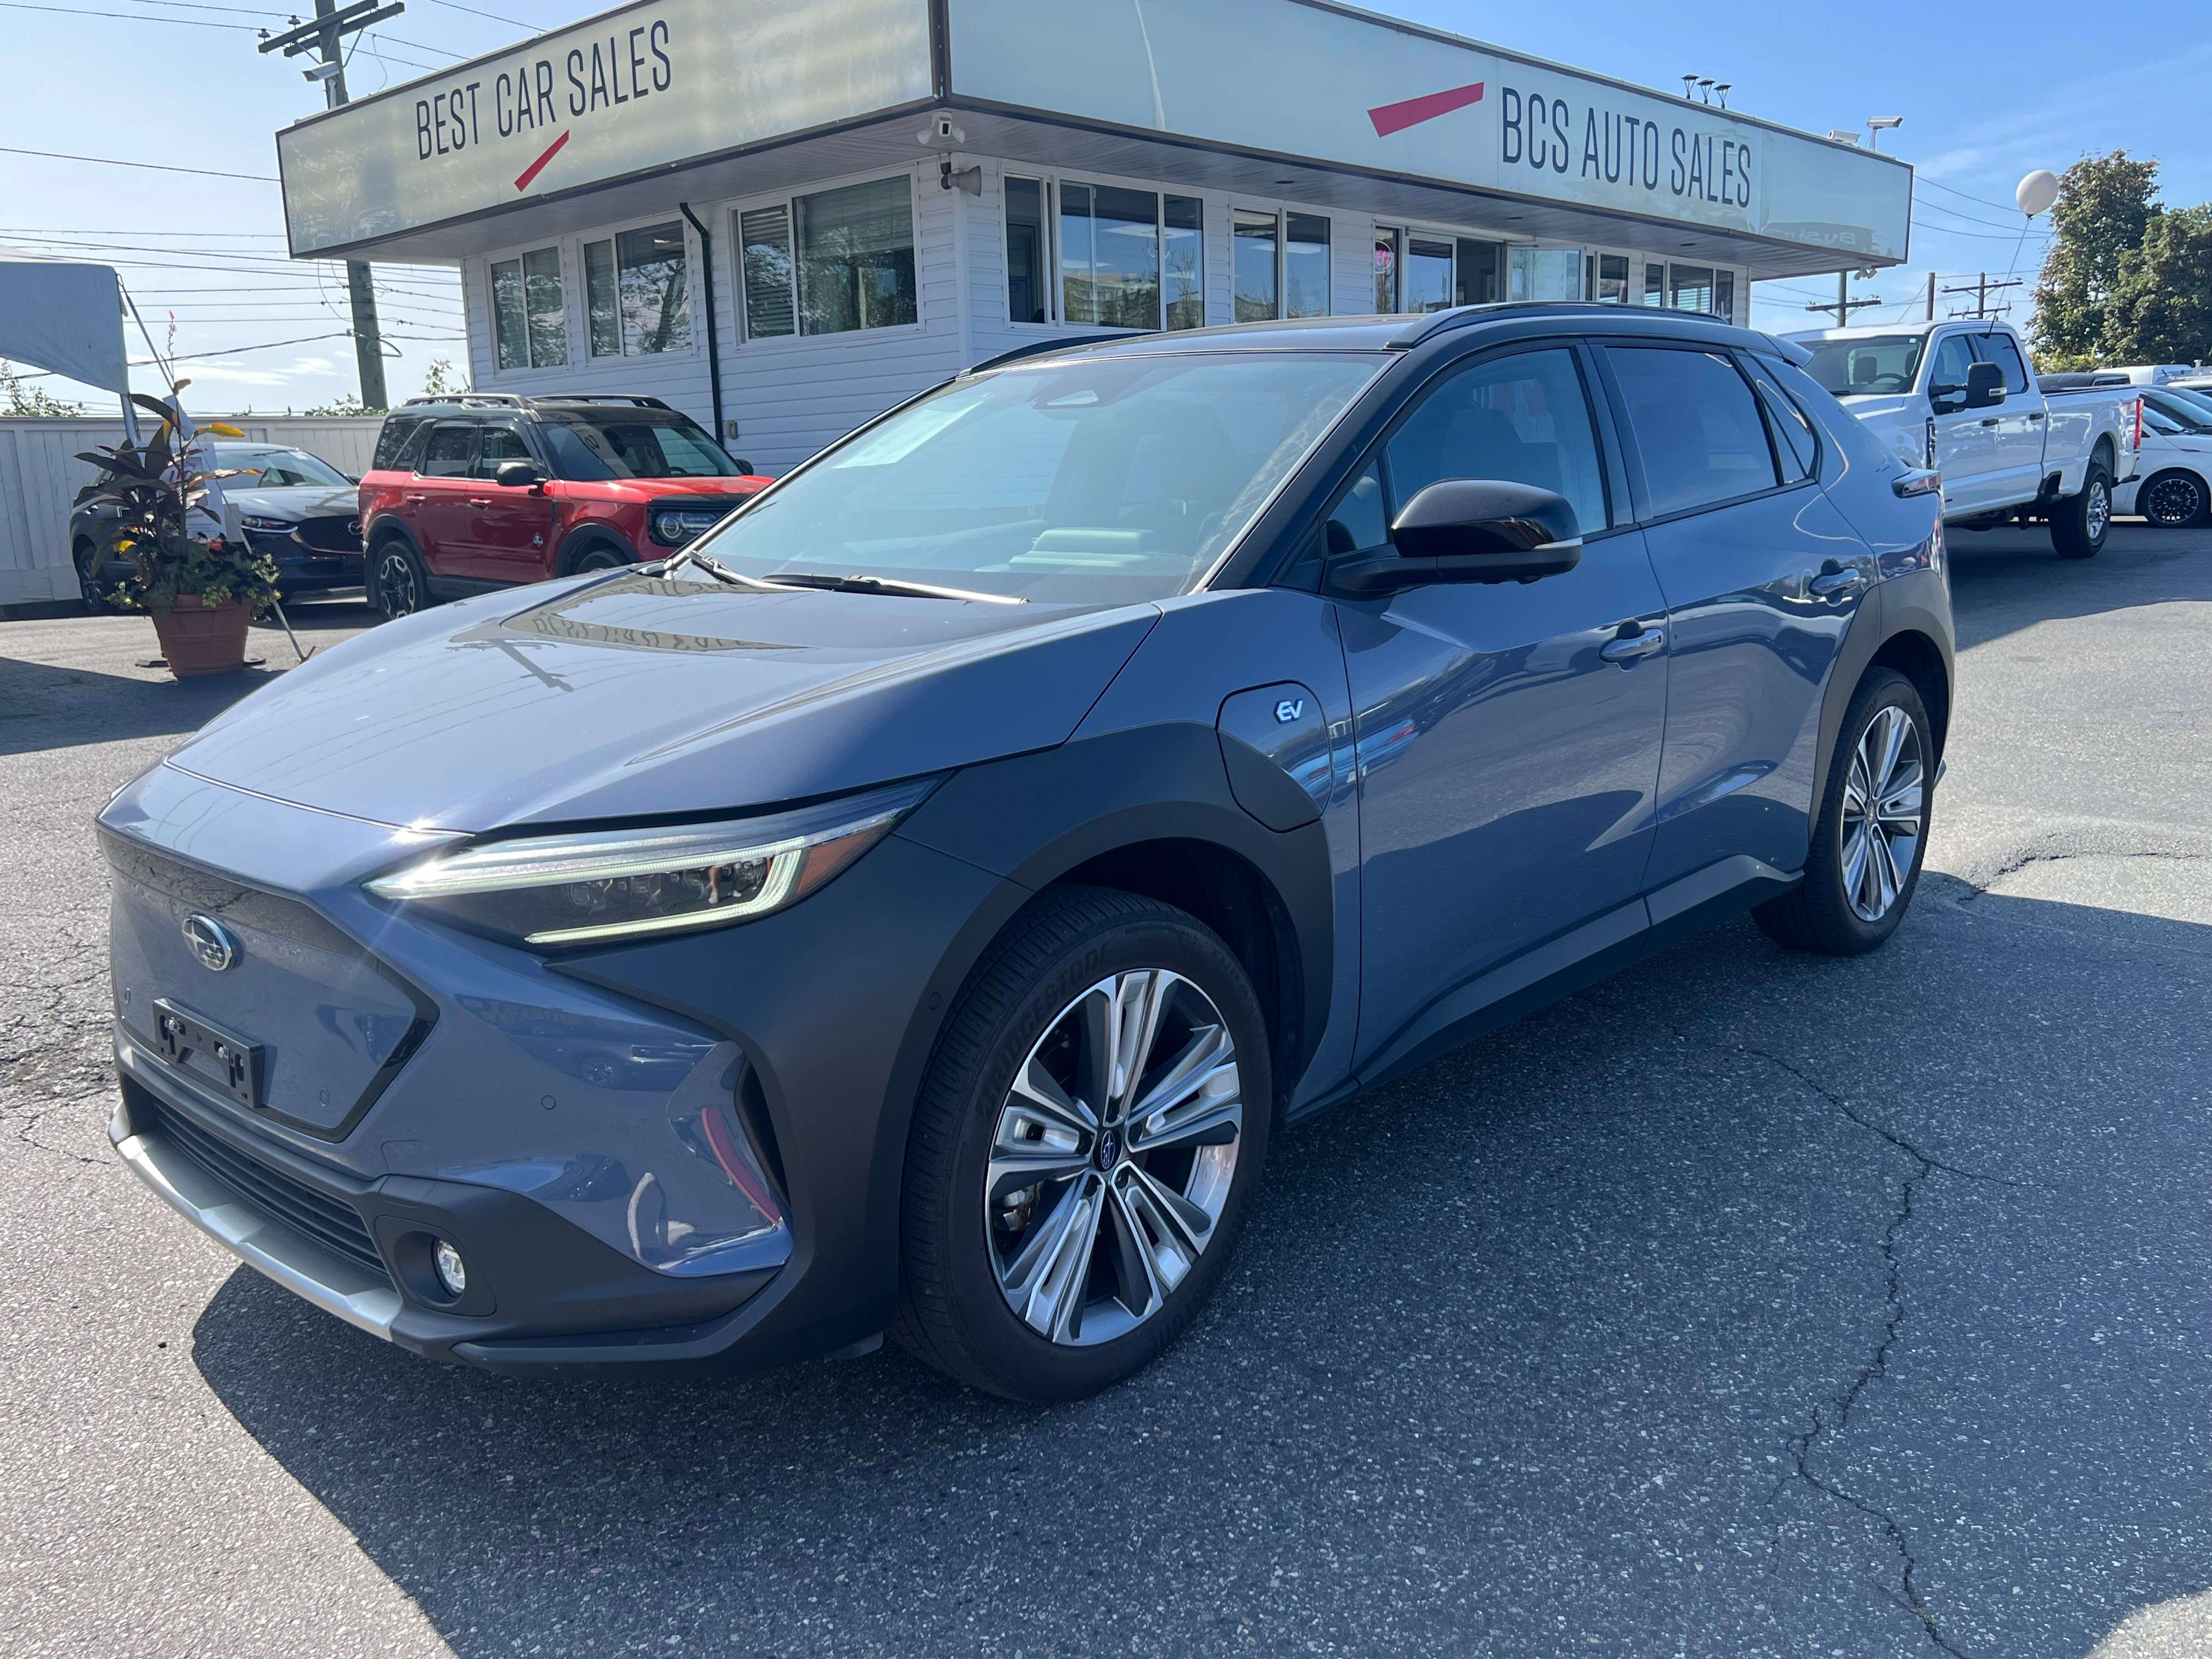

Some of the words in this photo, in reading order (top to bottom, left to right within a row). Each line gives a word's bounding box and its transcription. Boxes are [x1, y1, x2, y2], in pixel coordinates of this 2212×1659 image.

[416, 83, 481, 160] BEST
[496, 60, 556, 138] CAR
[567, 20, 671, 117] SALES
[1502, 87, 1569, 174] BCS
[1581, 108, 1658, 190] AUTO
[1671, 128, 1751, 208] SALES
[1274, 699, 1304, 724] EV
